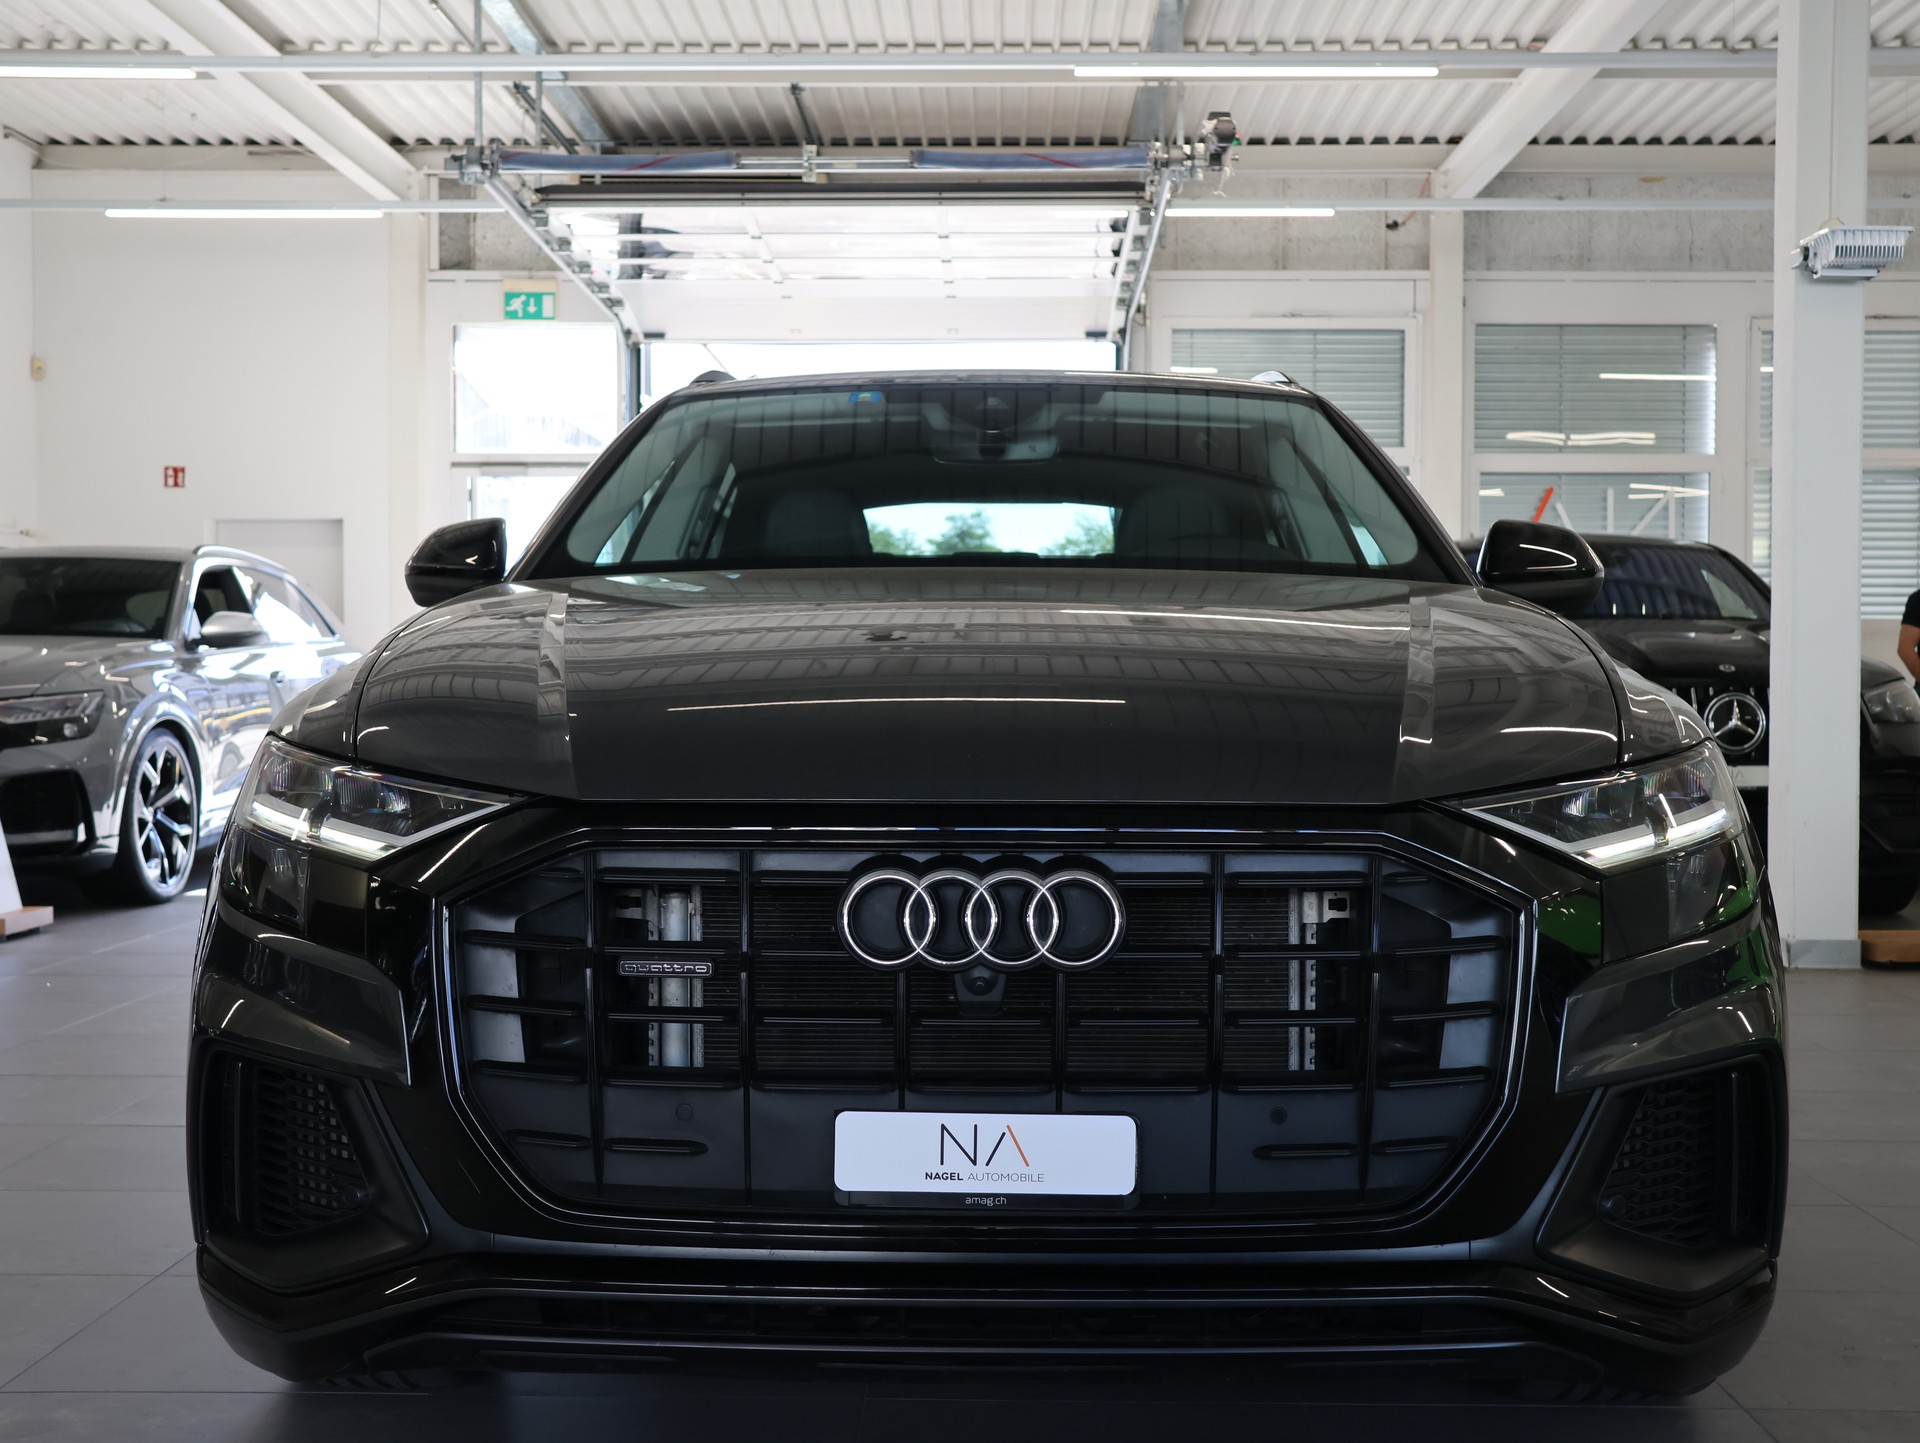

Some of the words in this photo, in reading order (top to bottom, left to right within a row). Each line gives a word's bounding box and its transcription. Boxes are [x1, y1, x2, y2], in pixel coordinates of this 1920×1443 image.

[624, 963, 707, 972] quattro
[924, 1171, 964, 1181] NAGEL
[967, 1172, 1044, 1182] AUTOMOBILE
[965, 1194, 1007, 1206] amag.ch
